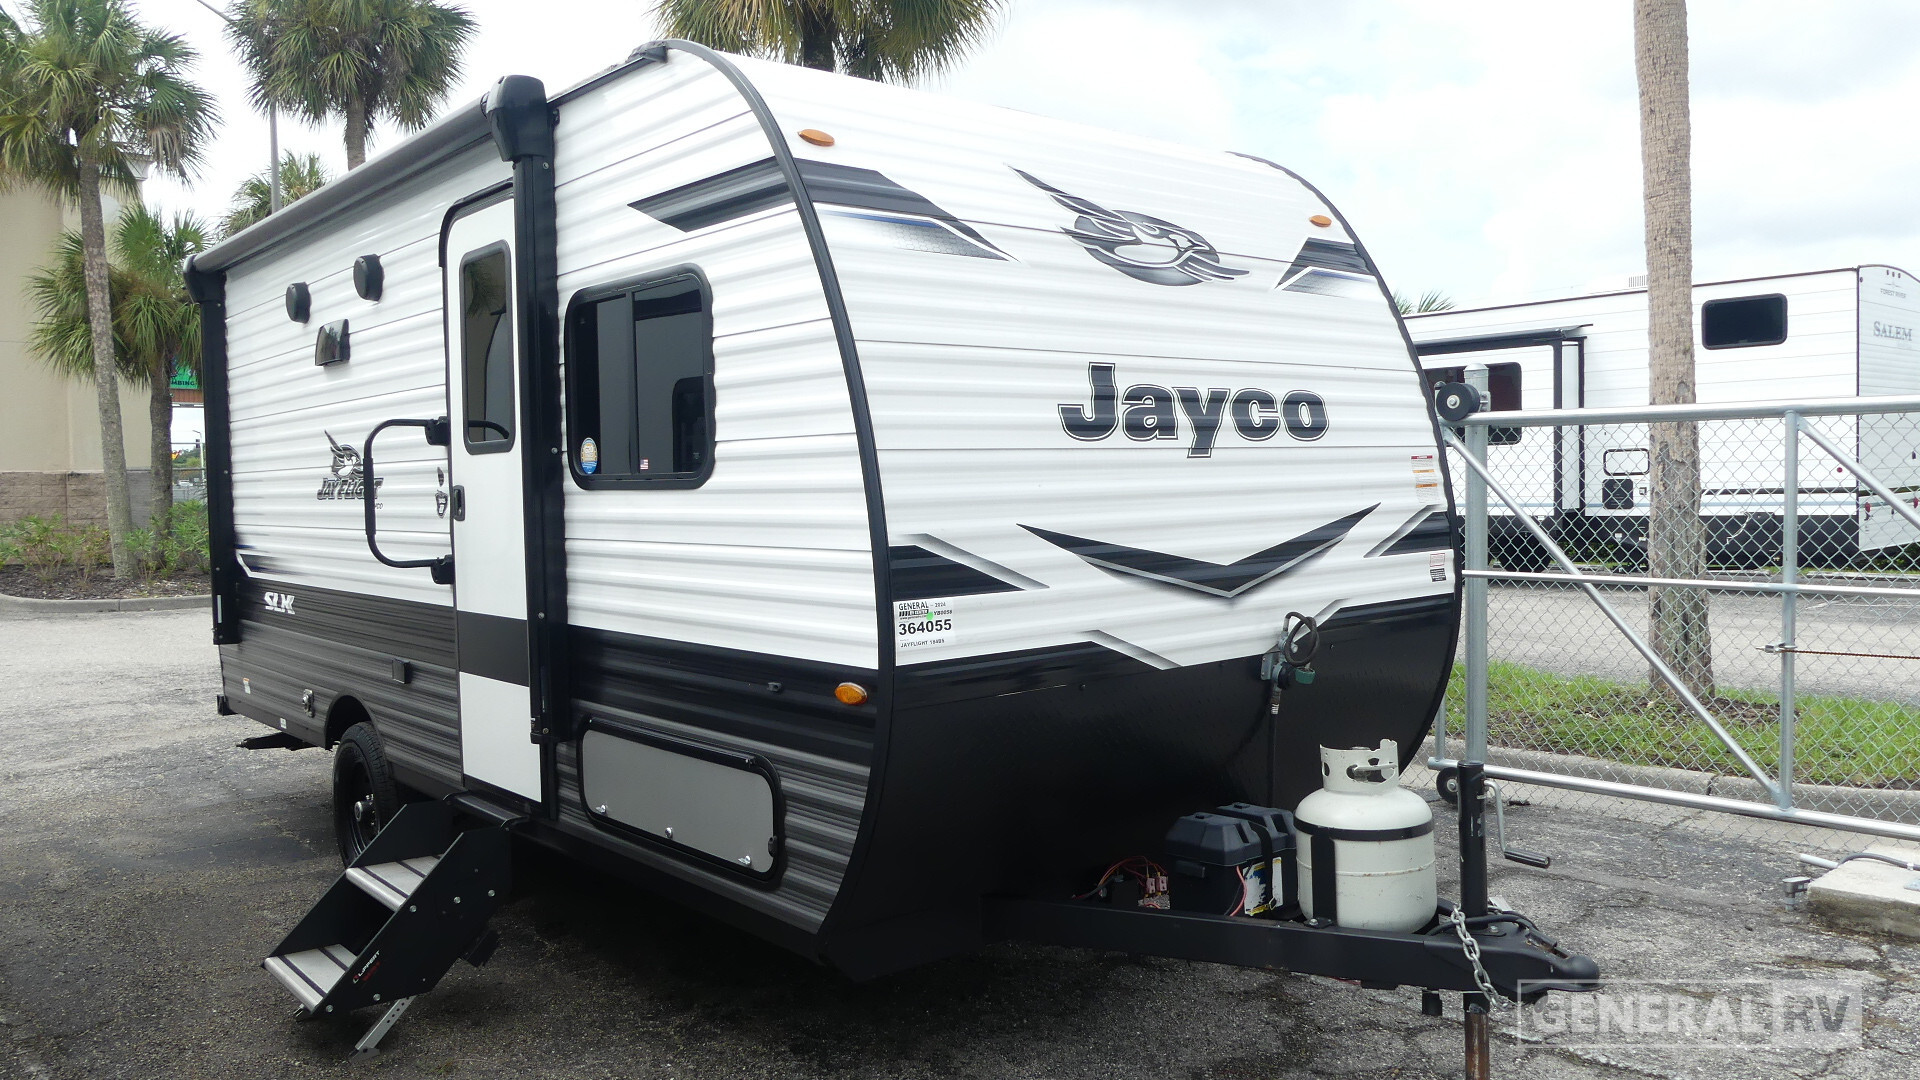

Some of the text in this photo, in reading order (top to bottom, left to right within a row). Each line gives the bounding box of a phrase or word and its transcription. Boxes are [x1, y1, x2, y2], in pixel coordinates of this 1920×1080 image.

[1873, 320, 1913, 341] SALEM
[1057, 361, 1330, 458] Jayco
[337, 477, 384, 500] FLIGT
[899, 601, 929, 610] GENERAL
[898, 618, 952, 636] 364055
[900, 640, 928, 648] JAYFLIGHT
